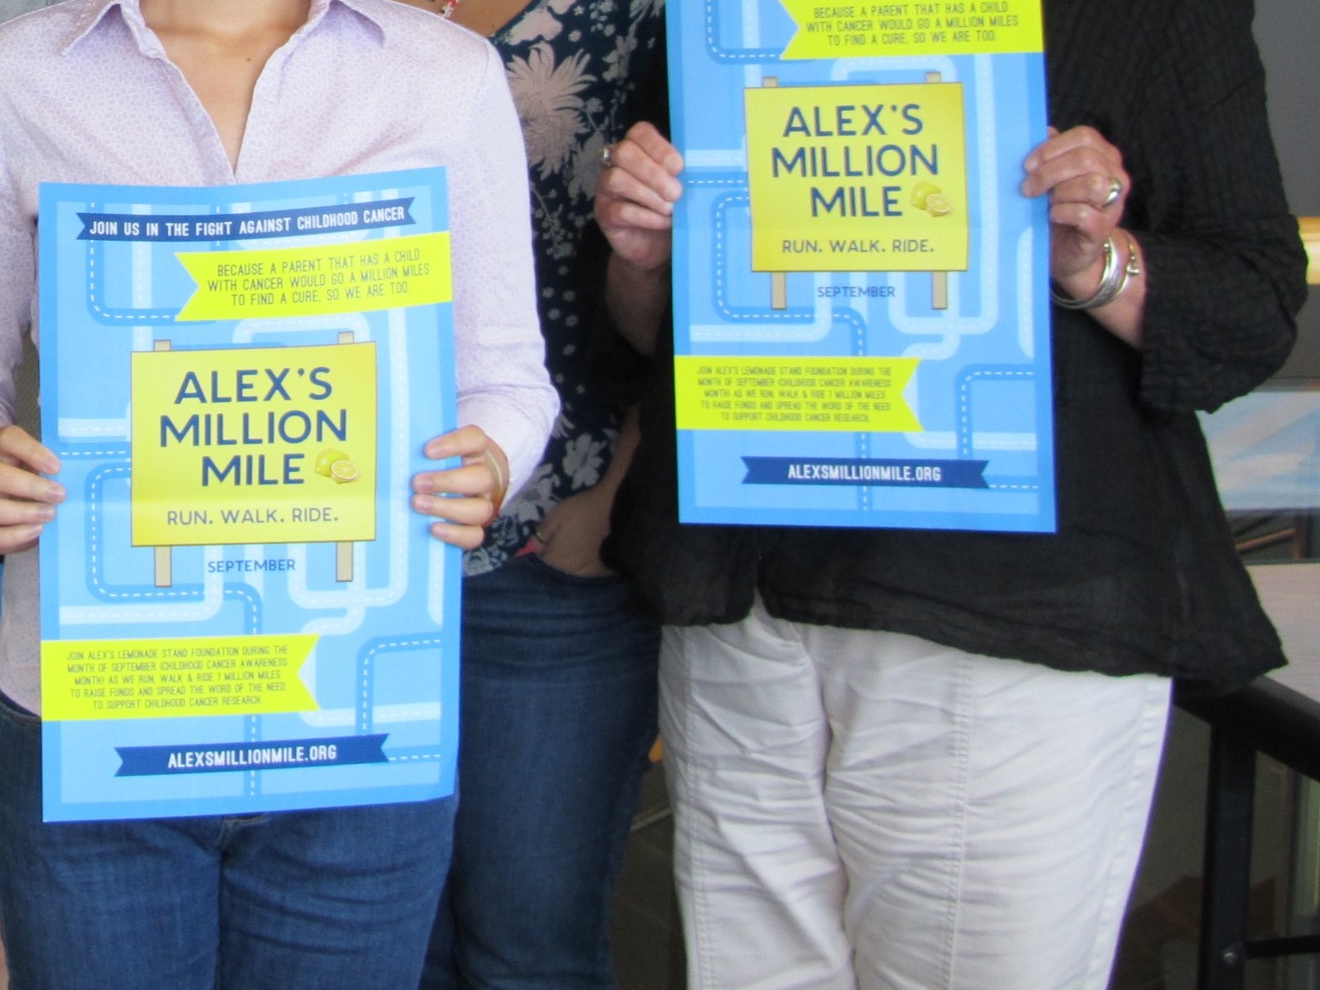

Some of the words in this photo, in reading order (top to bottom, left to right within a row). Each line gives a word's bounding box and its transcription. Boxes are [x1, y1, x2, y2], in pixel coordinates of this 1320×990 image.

[813, 5, 855, 18] BECAUSE
[860, 6, 866, 16] A
[870, 4, 908, 16] PARENT
[913, 3, 940, 14] THAT
[944, 2, 965, 13] HAS
[969, 3, 976, 12] A
[979, 1, 1008, 13] CHILD
[805, 20, 832, 32] WITH
[836, 19, 873, 31] CANCER
[879, 18, 912, 30] WOULD
[916, 17, 930, 29] GO
[934, 17, 941, 27] A
[945, 16, 984, 27] MILLION
[988, 14, 1018, 26] MILES
[826, 34, 840, 46] TO
[844, 33, 866, 45] FIND
[870, 34, 877, 43] A
[912, 32, 925, 43] SO
[930, 31, 946, 42] WE
[952, 30, 970, 41] ARE
[782, 103, 923, 137] ALEX'S
[771, 144, 938, 177] MILLION
[810, 186, 902, 217] MILE
[89, 221, 117, 234] JOIN
[123, 222, 139, 235] US
[145, 222, 158, 235] IN
[164, 222, 189, 236] THE
[195, 221, 232, 235] FIGHT
[238, 216, 291, 234] AGAINST
[296, 210, 359, 230] CHILDHOOD
[362, 205, 405, 223] CANCER
[781, 239, 822, 253] RUN.
[828, 239, 886, 252] WALK.
[892, 239, 934, 252] RIDE.
[216, 262, 264, 276] BECAUSE
[269, 262, 277, 274] A
[281, 258, 322, 273] PARENT
[327, 255, 354, 268] THAT
[359, 253, 378, 264] HAS
[383, 253, 389, 263] A
[394, 248, 419, 262] CHILD
[206, 279, 237, 291] WITH
[241, 276, 283, 290] CANCER
[288, 273, 325, 287] WOULD
[331, 272, 343, 284] GO
[349, 272, 355, 281] A
[360, 267, 397, 280] MILLION
[402, 262, 429, 276] MILES
[230, 293, 245, 306] TO
[249, 292, 274, 305] FIND
[279, 292, 287, 304] A
[326, 288, 339, 300] SO
[344, 285, 360, 298] WE
[366, 283, 384, 296] ARE
[817, 285, 895, 298] SEPTEMBER
[173, 366, 332, 404] ALEX'S
[159, 408, 346, 447] MILLION
[201, 453, 304, 486] MILE
[787, 464, 941, 481] ALEXSMILLIONMILE.ORG
[166, 510, 213, 525] RUN.
[220, 508, 284, 523] WALK.
[291, 507, 338, 522] RIDE.
[207, 558, 296, 572] SEPTEMBER
[92, 700, 103, 709] TO
[106, 699, 141, 709] SUPPORT
[144, 697, 185, 707] CHILDHOOD
[188, 696, 218, 706] CANCER
[167, 744, 336, 768] ALEXSMILLIONMILE.ORG
